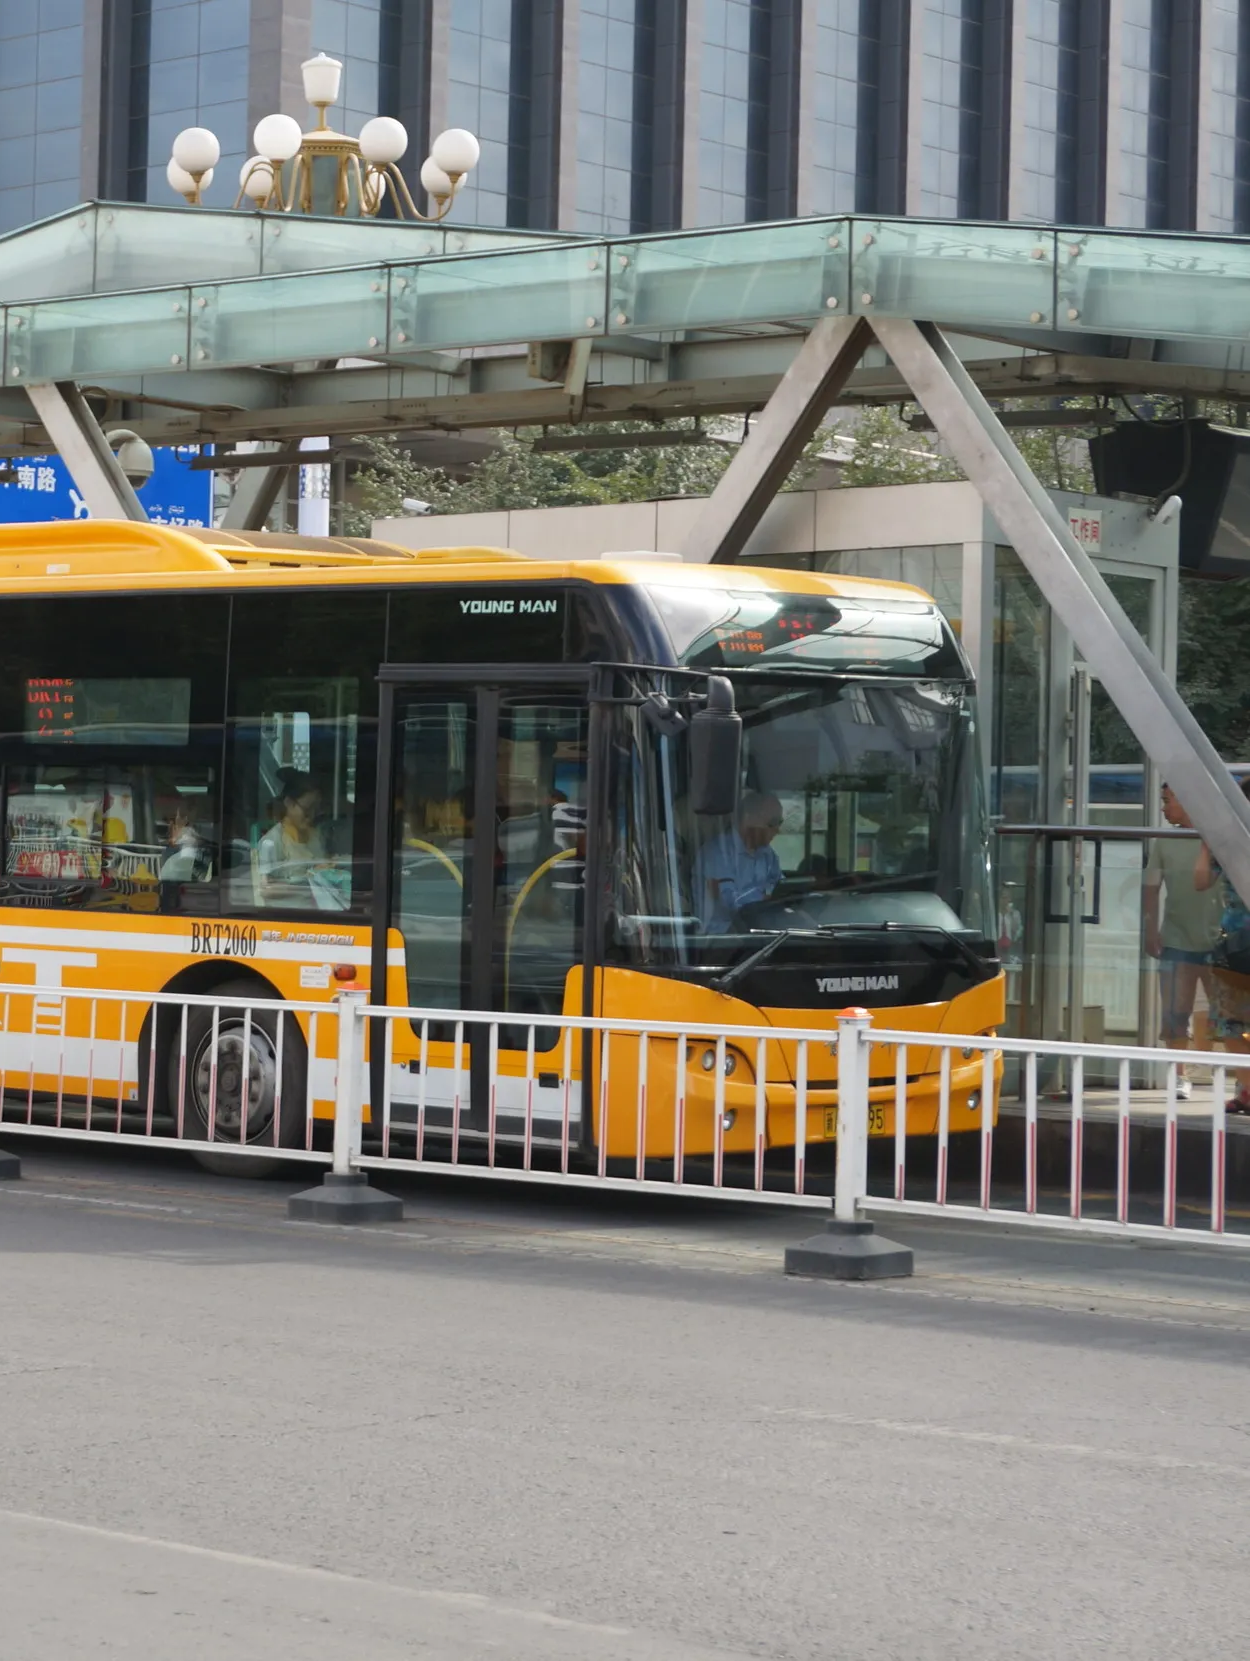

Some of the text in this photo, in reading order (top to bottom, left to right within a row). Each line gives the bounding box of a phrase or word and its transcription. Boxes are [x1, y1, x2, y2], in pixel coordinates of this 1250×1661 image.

[459, 599, 558, 614] YOUNG MAN
[191, 922, 257, 957] BRT2060
